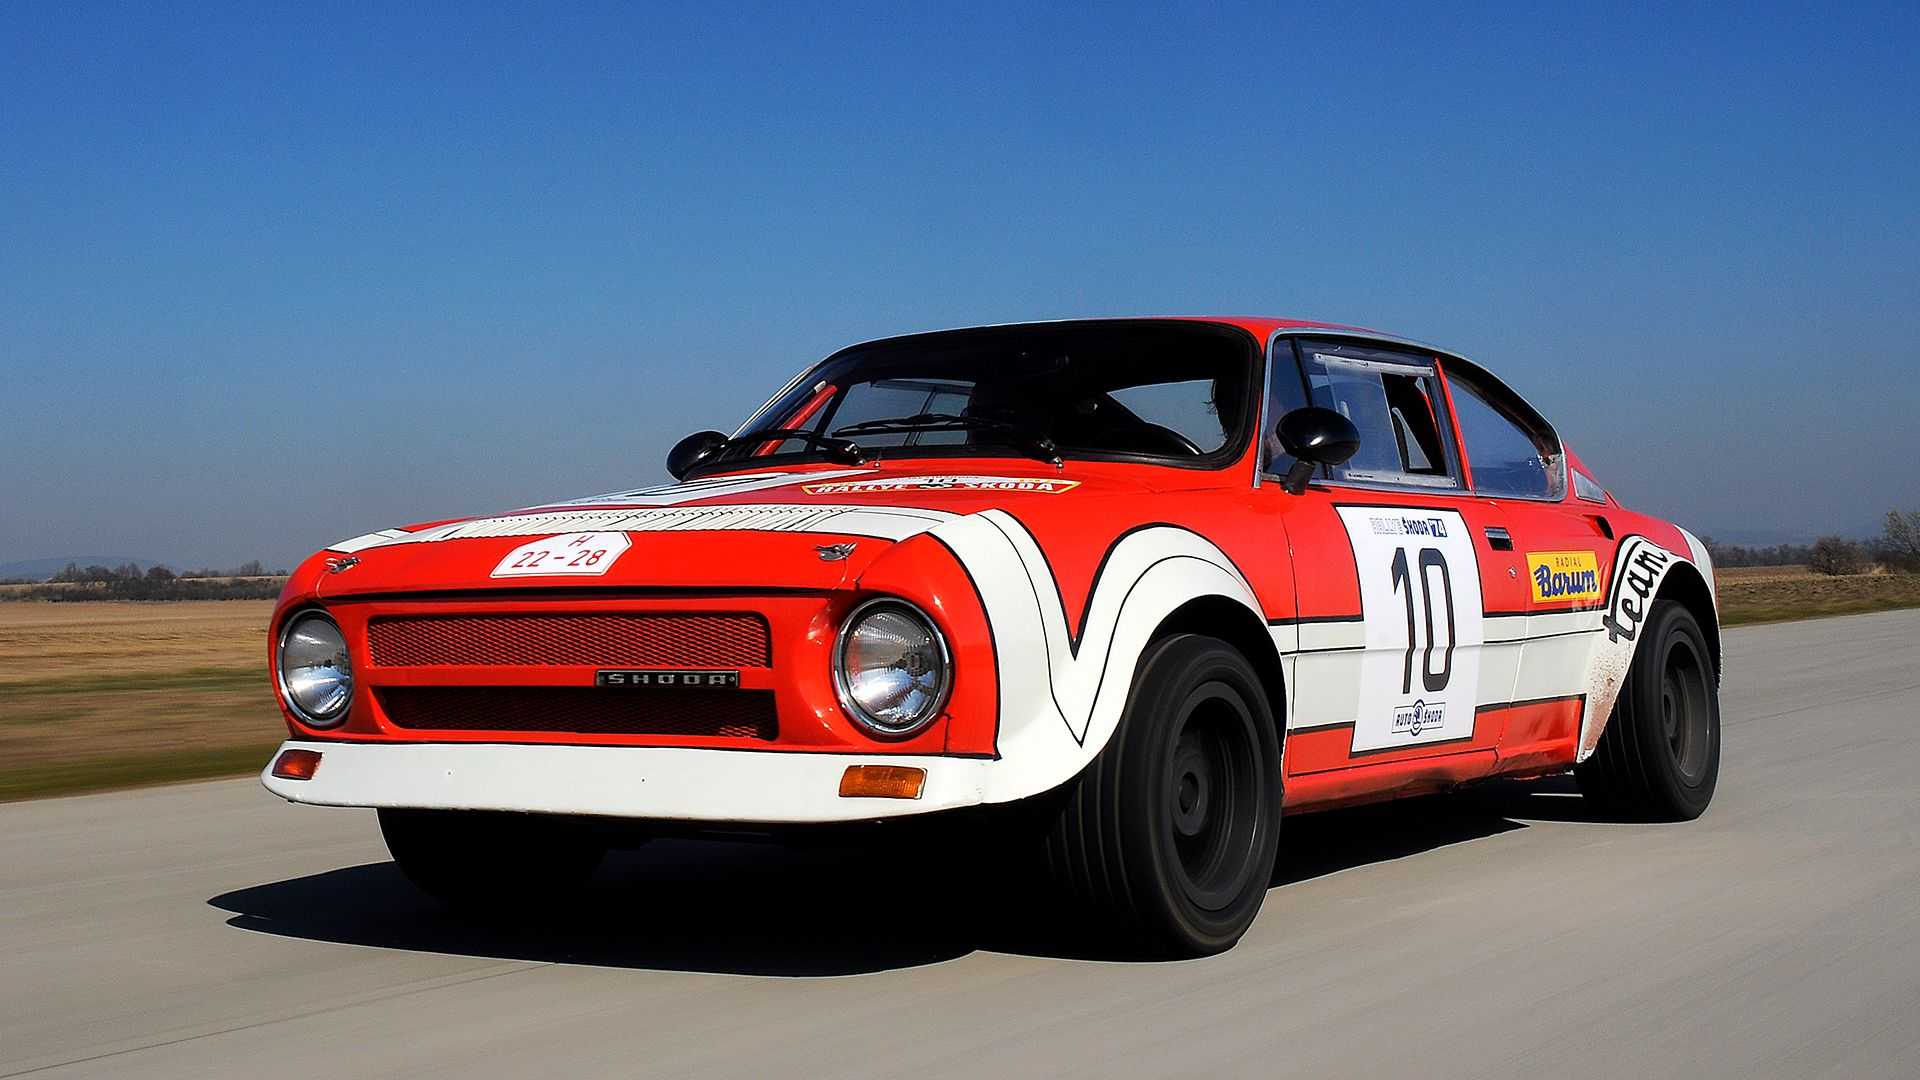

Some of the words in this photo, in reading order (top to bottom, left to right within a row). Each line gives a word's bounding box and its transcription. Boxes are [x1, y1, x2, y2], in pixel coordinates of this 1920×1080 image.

[568, 535, 595, 547] H
[1555, 556, 1582, 568] RADIAL
[1533, 564, 1598, 598] Barum
[1602, 541, 1669, 644] team
[1391, 547, 1455, 694] 10
